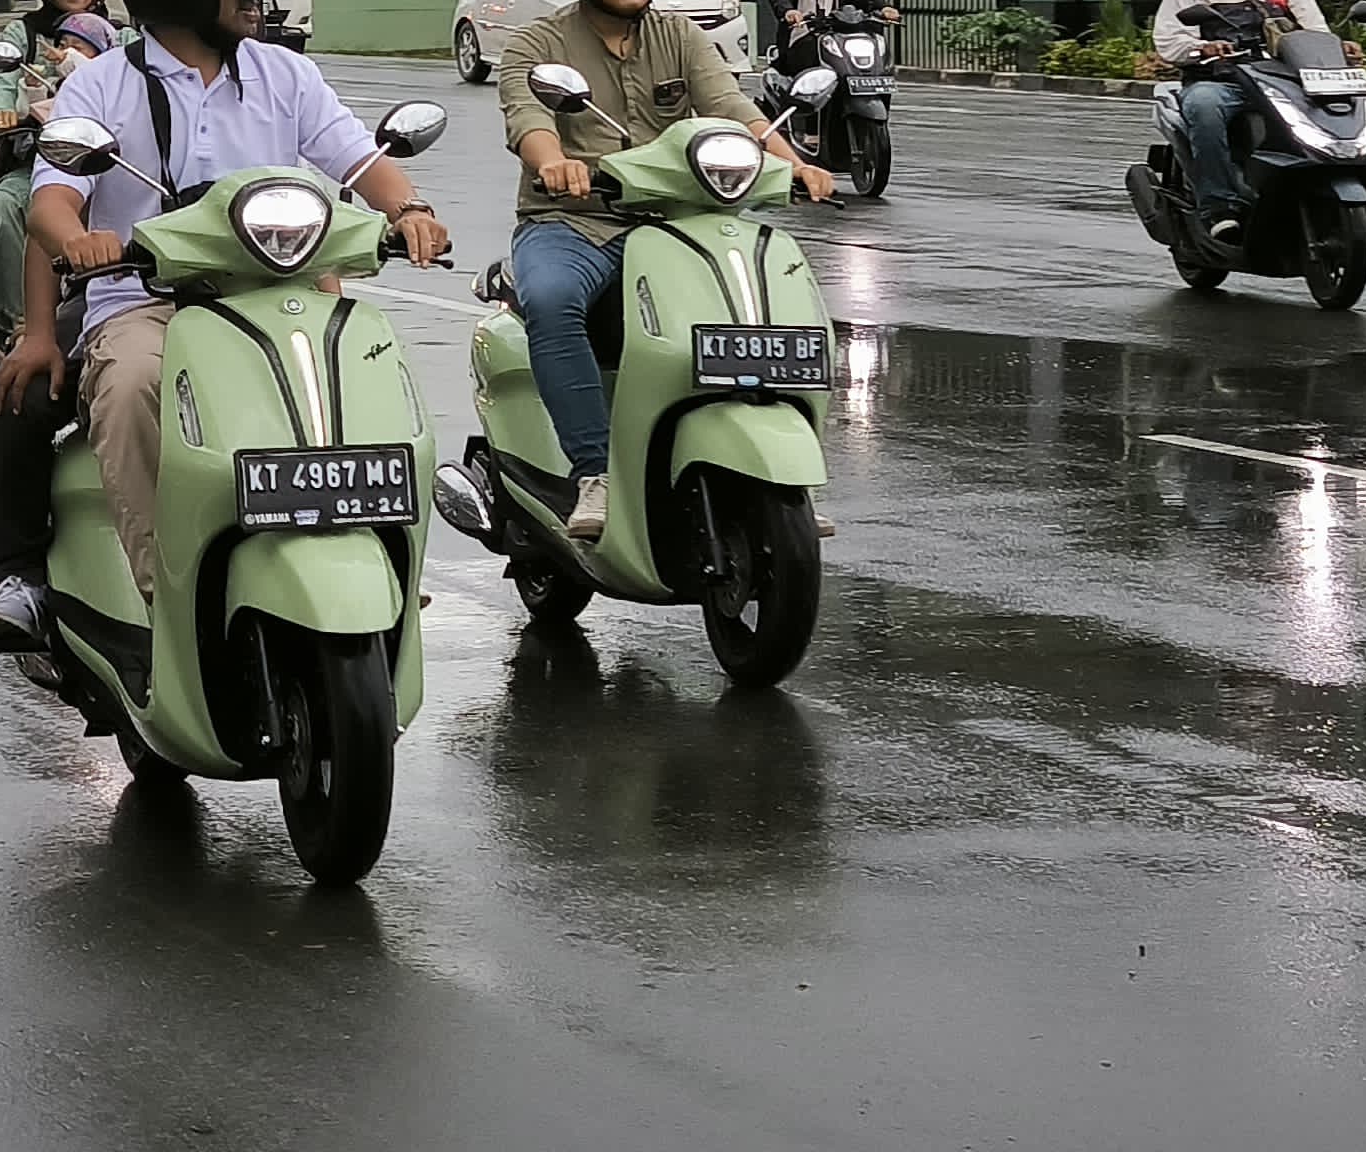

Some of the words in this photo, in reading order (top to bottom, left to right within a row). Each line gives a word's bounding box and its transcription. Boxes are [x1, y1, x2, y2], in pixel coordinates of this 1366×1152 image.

[702, 335, 727, 358] KT
[734, 336, 786, 358] 3815
[795, 337, 822, 360] BF
[248, 463, 279, 491] KT
[291, 460, 357, 490] 4967
[365, 458, 404, 488] MC
